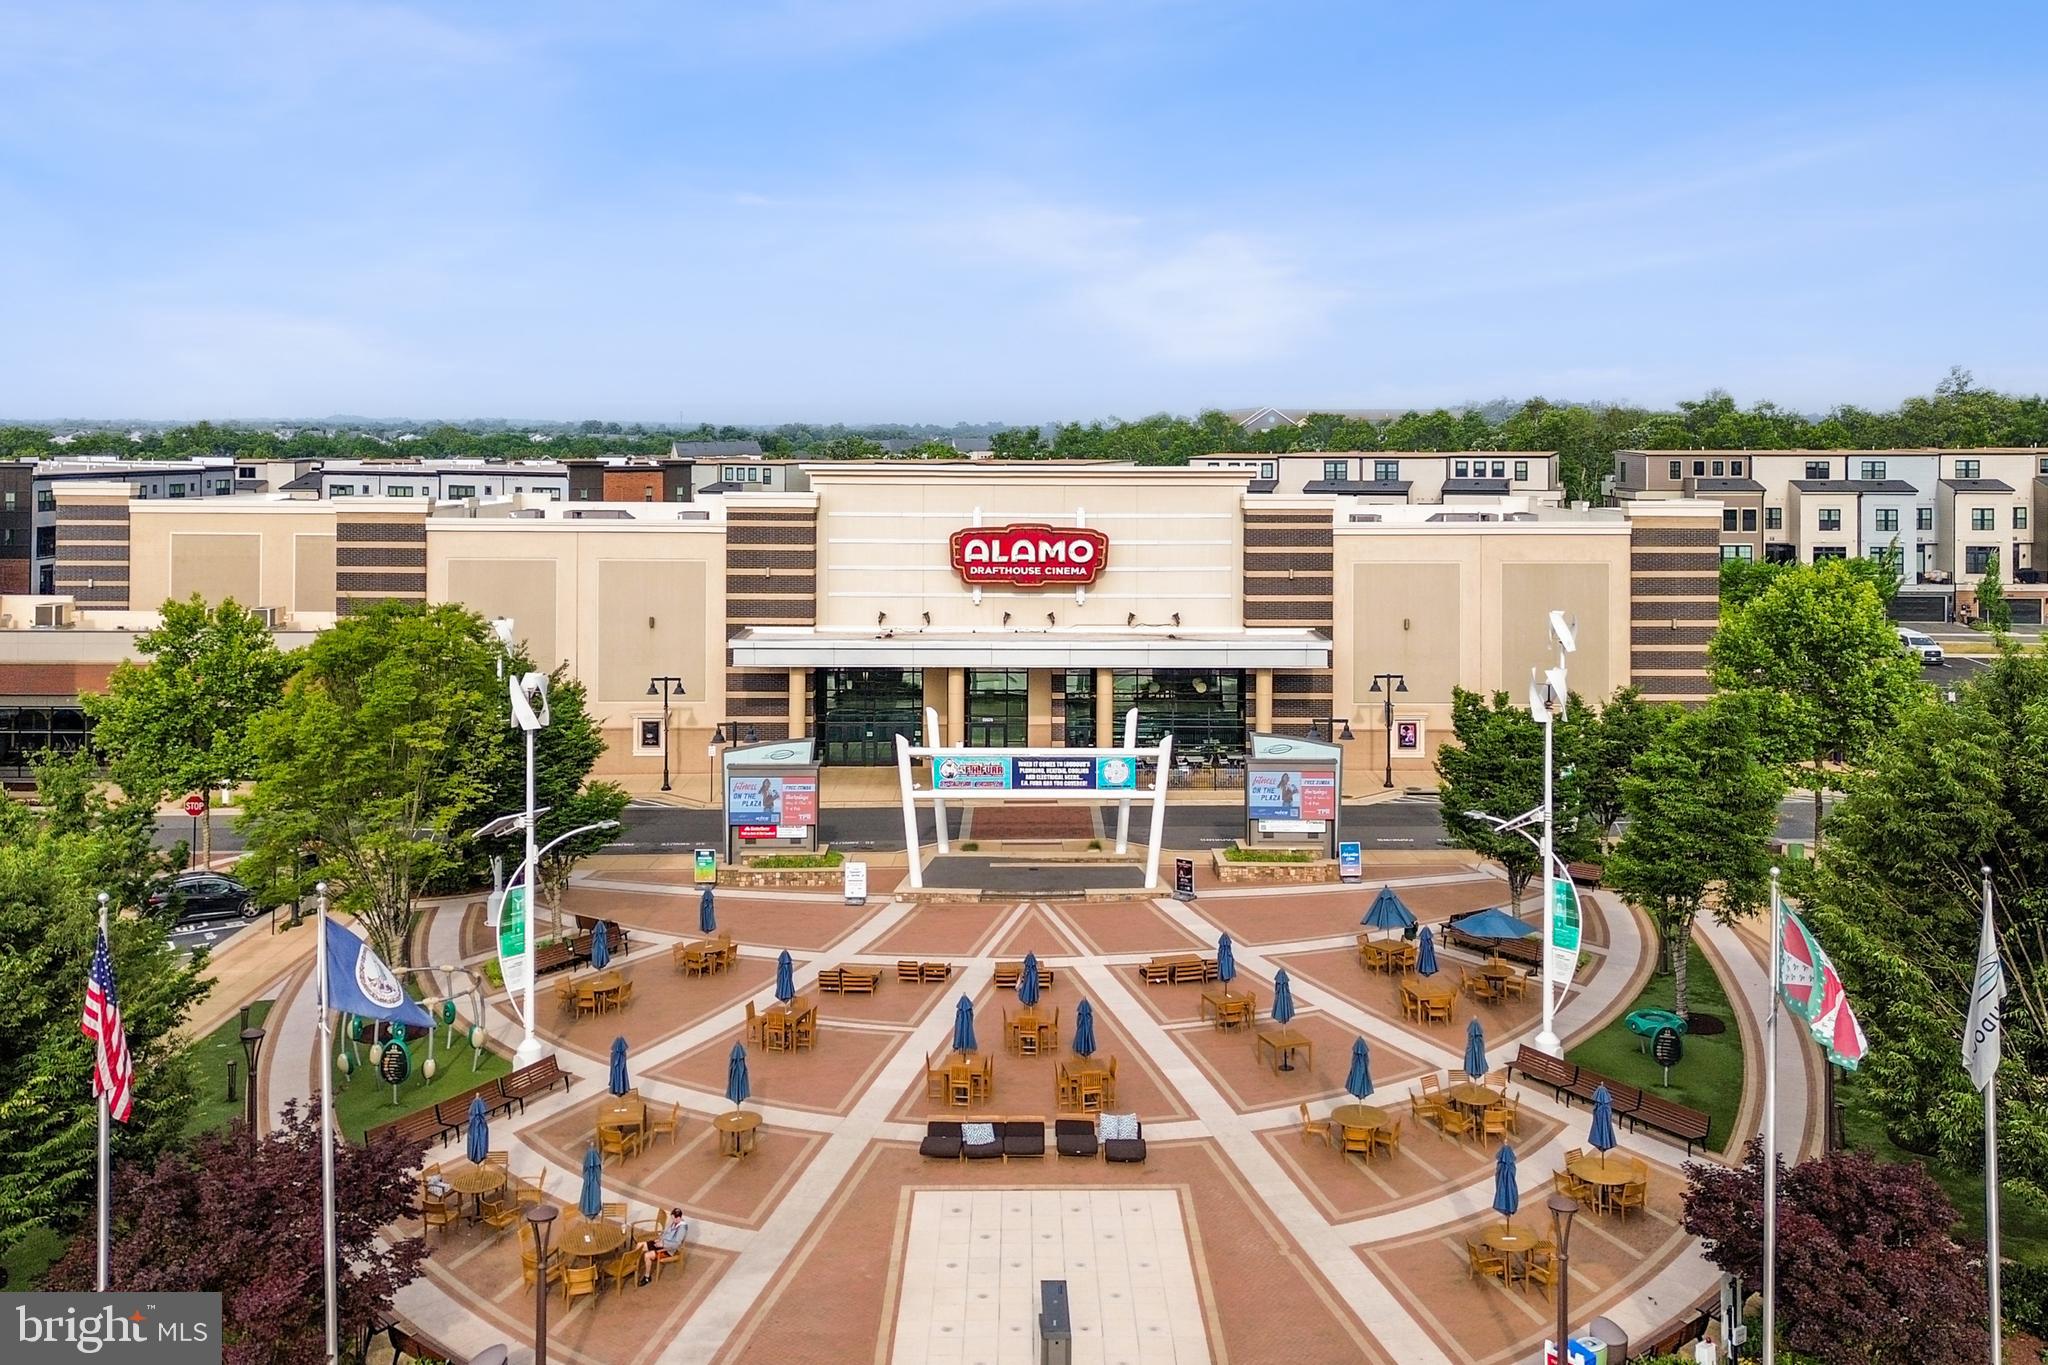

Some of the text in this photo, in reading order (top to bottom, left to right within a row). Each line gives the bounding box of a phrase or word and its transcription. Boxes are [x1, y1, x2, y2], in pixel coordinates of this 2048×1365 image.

[964, 539, 1095, 563] ALAMO
[970, 566, 1087, 576] DRAFTHOUSE CINEMA
[186, 802, 204, 810] STOP
